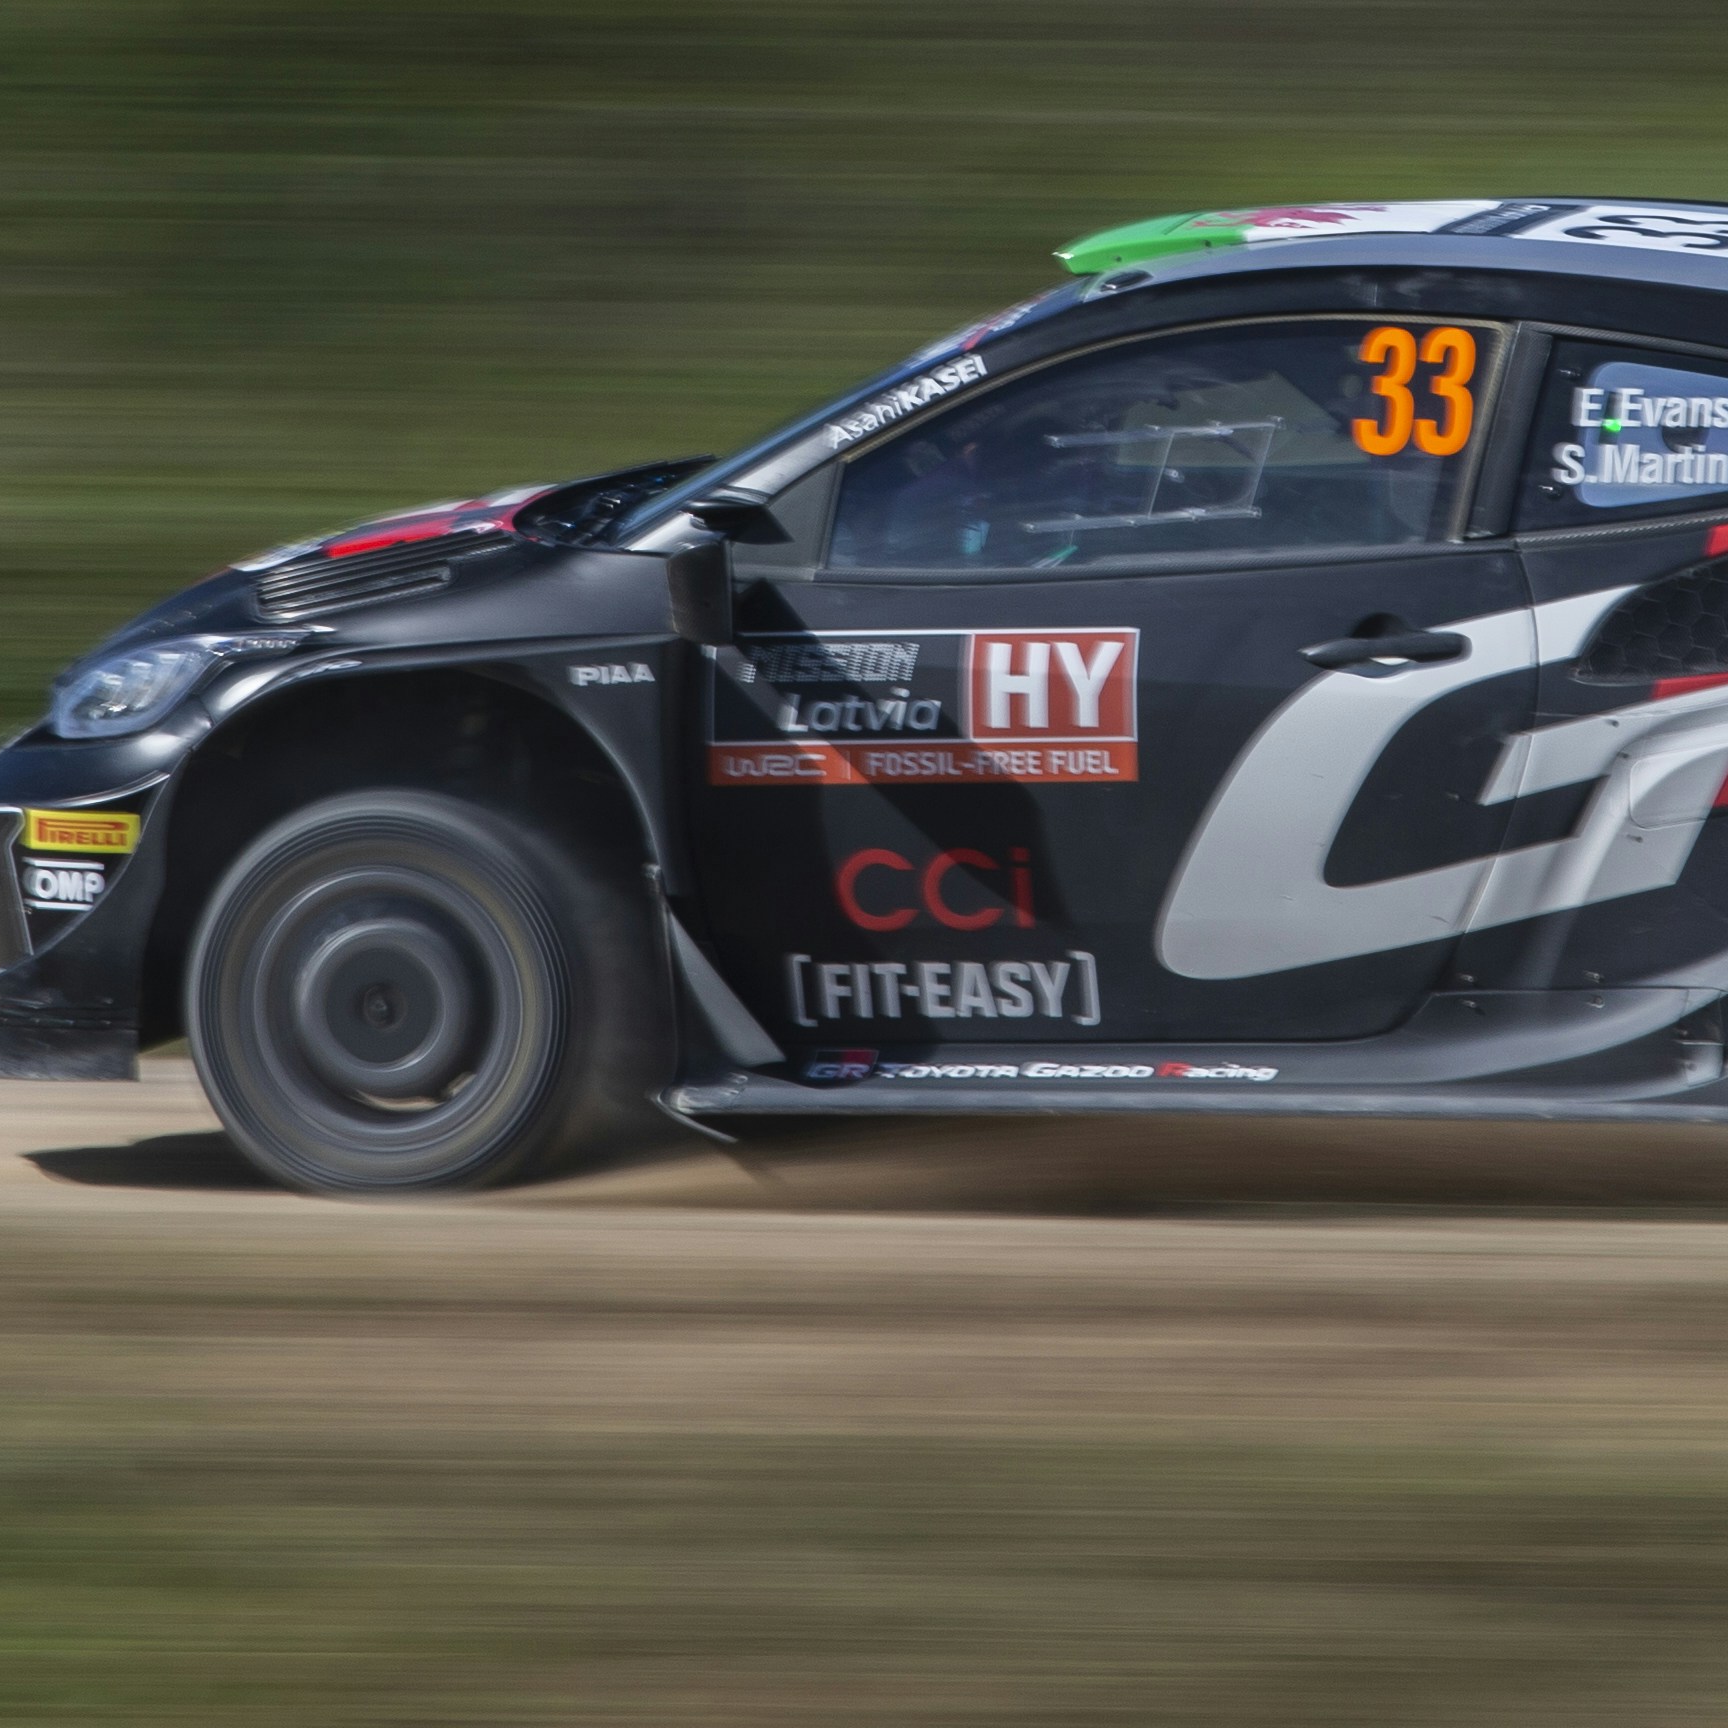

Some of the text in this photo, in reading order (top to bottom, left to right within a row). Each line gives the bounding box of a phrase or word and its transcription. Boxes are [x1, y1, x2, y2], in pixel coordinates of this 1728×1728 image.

[1353, 326, 1477, 456] 33
[569, 662, 656, 687] PIAA
[985, 641, 1124, 729] HY
[776, 686, 942, 733] Latvia
[864, 749, 1120, 776] FOSSIL-FREE FUEL
[35, 817, 129, 847] PIRELLI
[23, 866, 105, 903] OMP
[807, 1061, 870, 1079] GR
[874, 1062, 1019, 1078] TOYOTA
